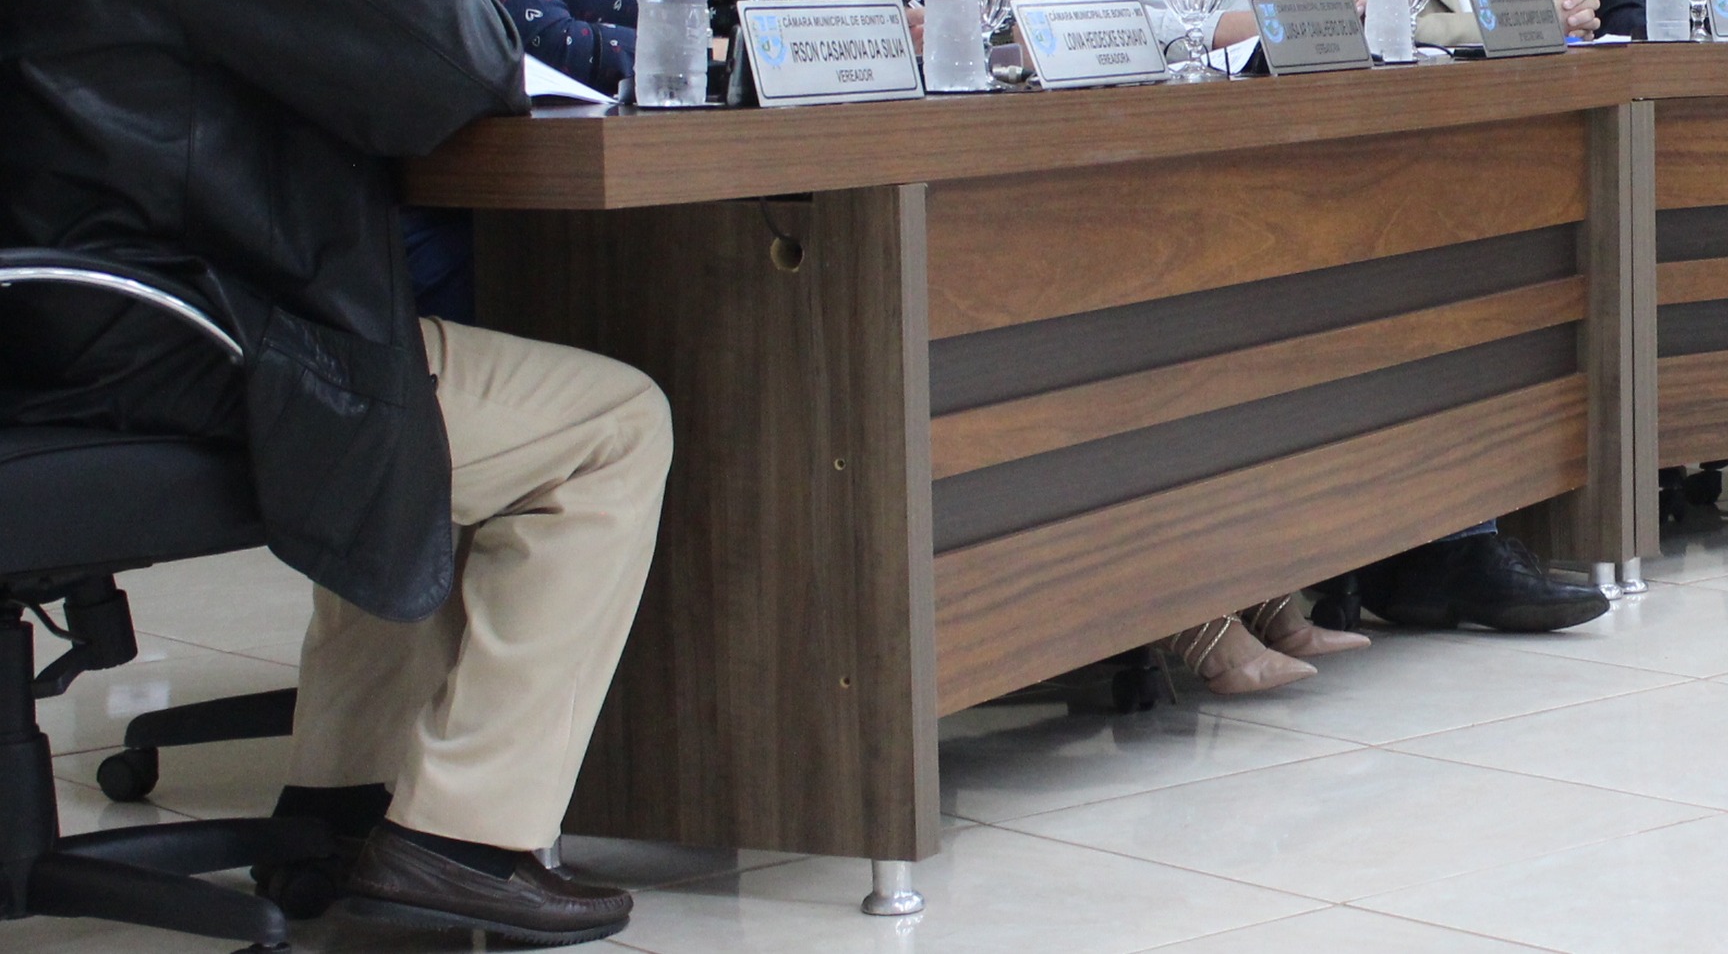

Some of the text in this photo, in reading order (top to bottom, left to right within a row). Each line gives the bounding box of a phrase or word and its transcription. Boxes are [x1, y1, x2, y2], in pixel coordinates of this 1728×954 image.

[812, 15, 850, 27] MUNICIPAL
[849, 14, 860, 26] DE
[859, 14, 885, 25] BONITO
[888, 13, 899, 24] MS
[1072, 9, 1102, 20] MUNICIPAL
[1101, 9, 1111, 18] DE
[1110, 8, 1132, 18] BONITO
[789, 37, 906, 63] IRSON CASANOVA DA SILVA
[1095, 52, 1131, 65] VEREADORA
[835, 68, 874, 82] VEREADOR
